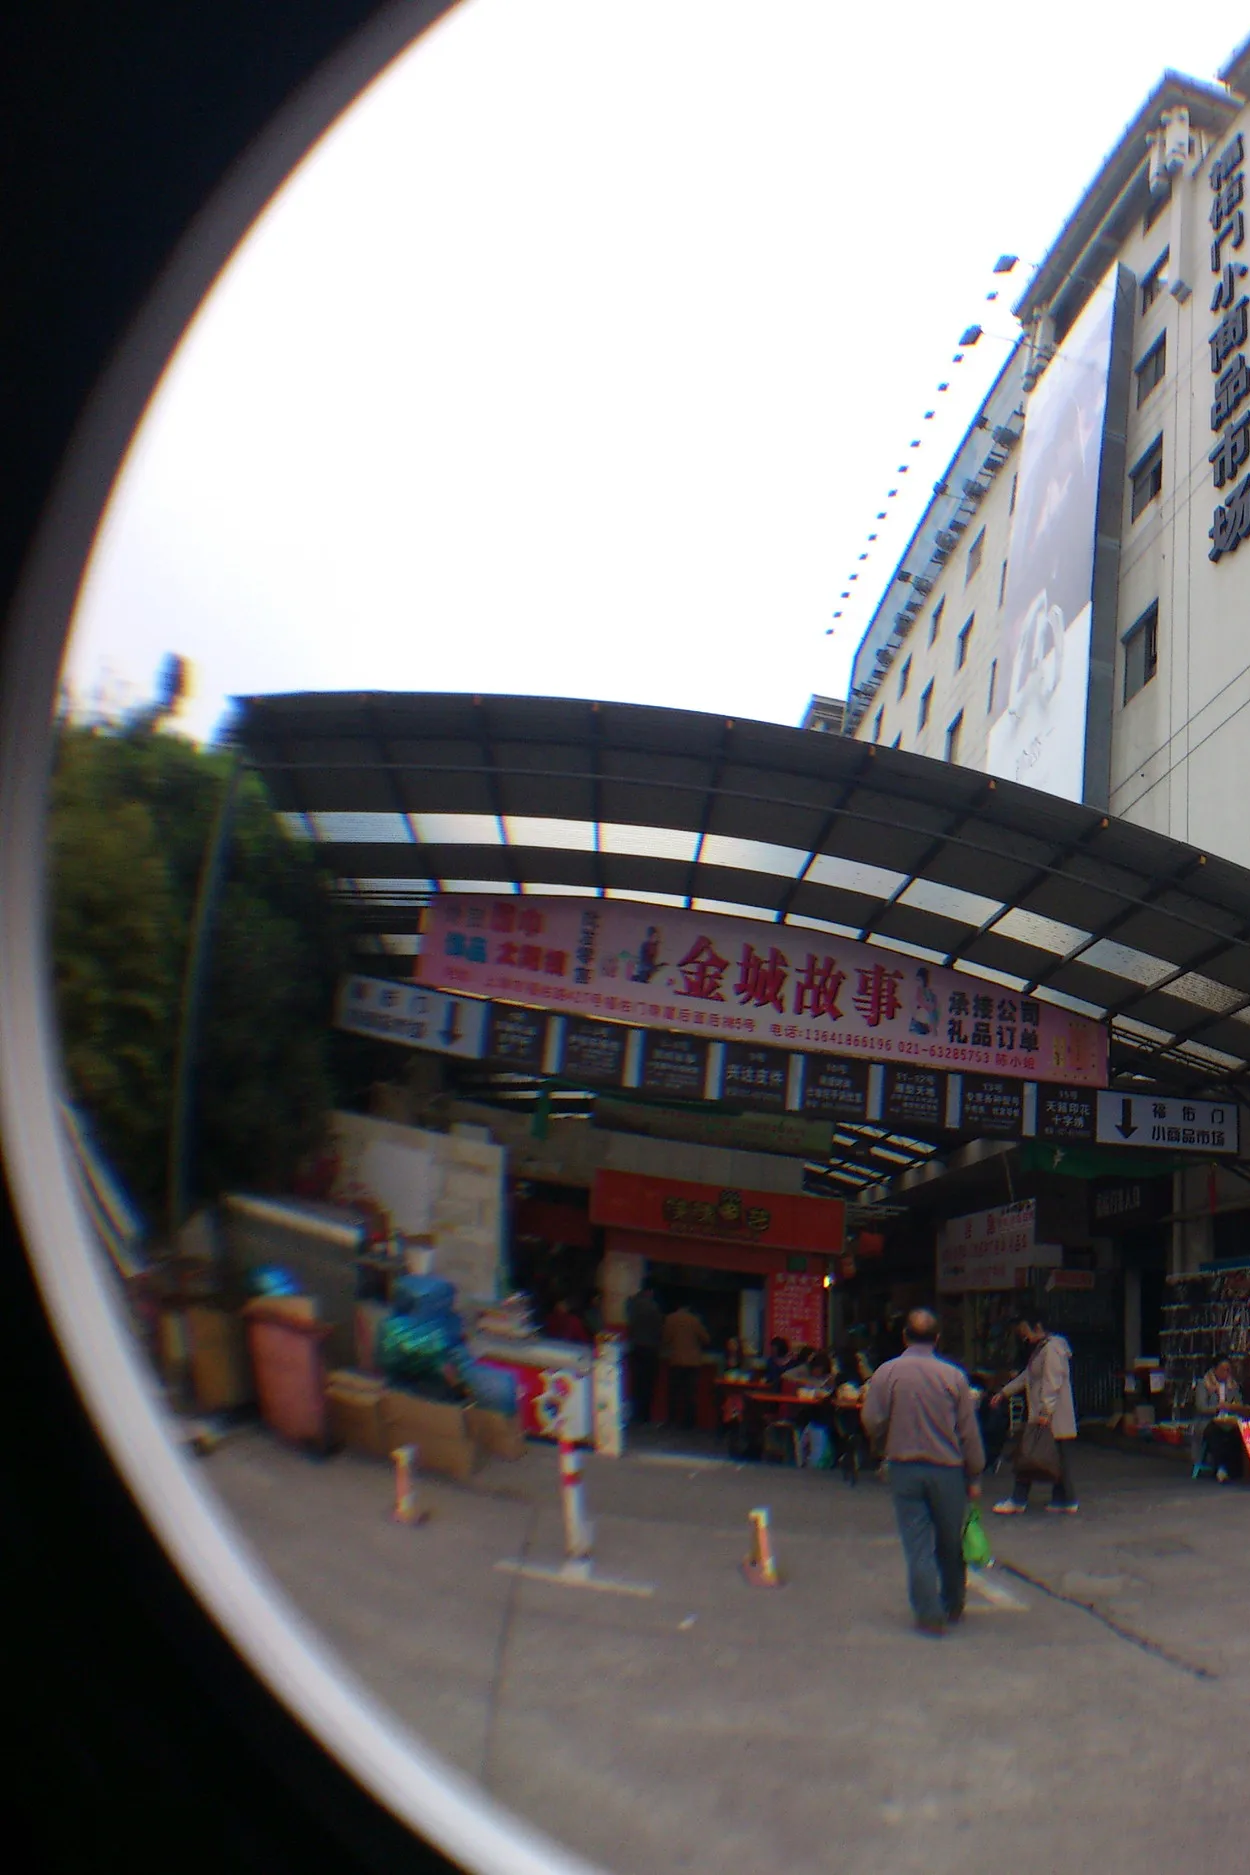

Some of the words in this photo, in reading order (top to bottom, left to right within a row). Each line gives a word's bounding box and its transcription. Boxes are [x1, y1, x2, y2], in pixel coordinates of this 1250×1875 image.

[673, 934, 907, 1028] 金城故事
[948, 991, 1040, 1026] 承接公司
[947, 1018, 1040, 1052] 礼品订单
[1152, 1102, 1224, 1124] 福佑门
[1151, 1125, 1225, 1146] 小商品市场
